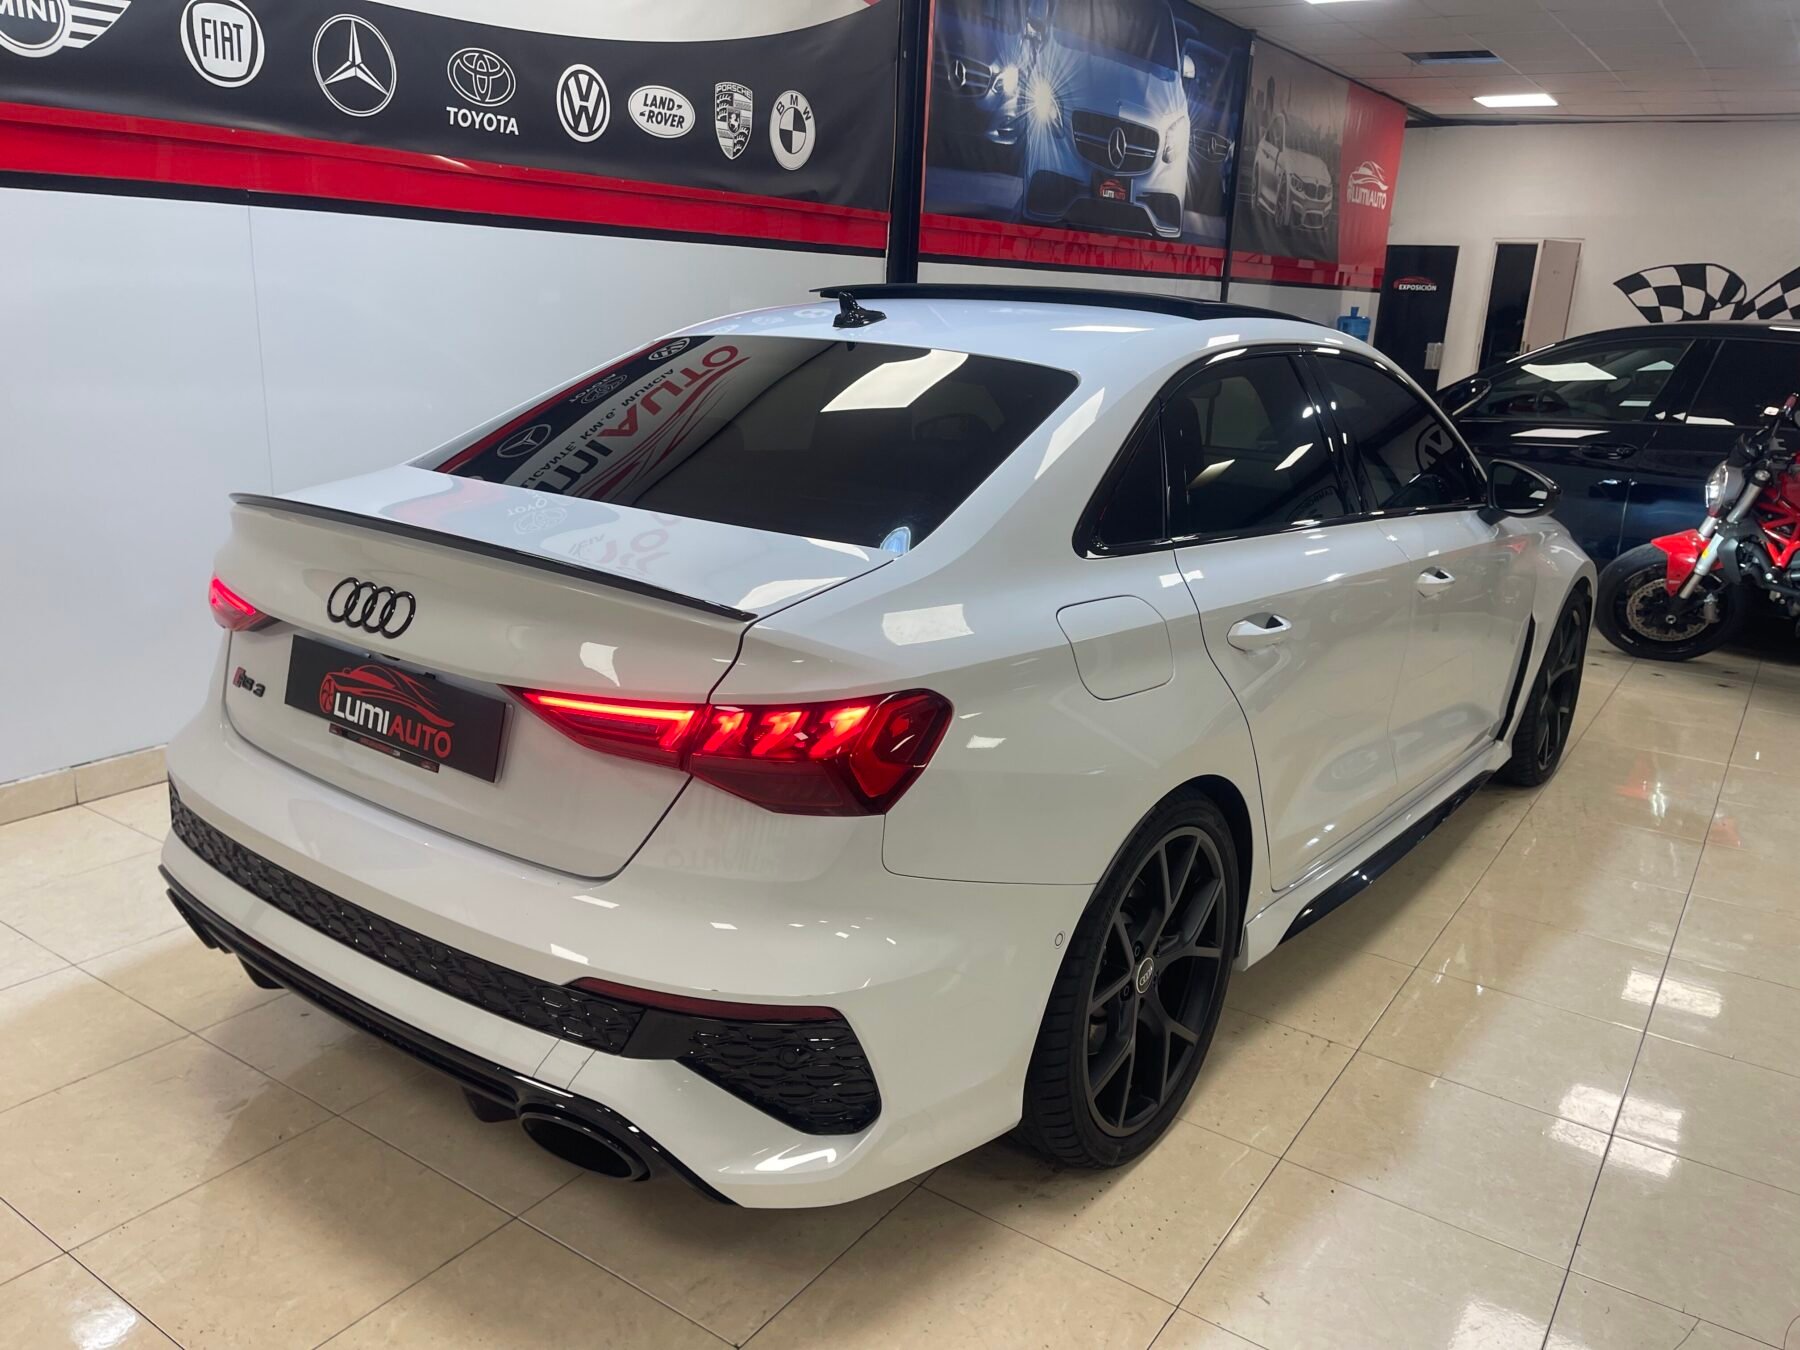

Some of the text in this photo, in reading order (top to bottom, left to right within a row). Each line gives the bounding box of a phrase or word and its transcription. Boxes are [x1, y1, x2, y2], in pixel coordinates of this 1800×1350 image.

[201, 18, 243, 62] FIAT
[643, 93, 676, 111] LAND
[446, 106, 519, 135] TOYOTA
[646, 109, 685, 129] ROVER
